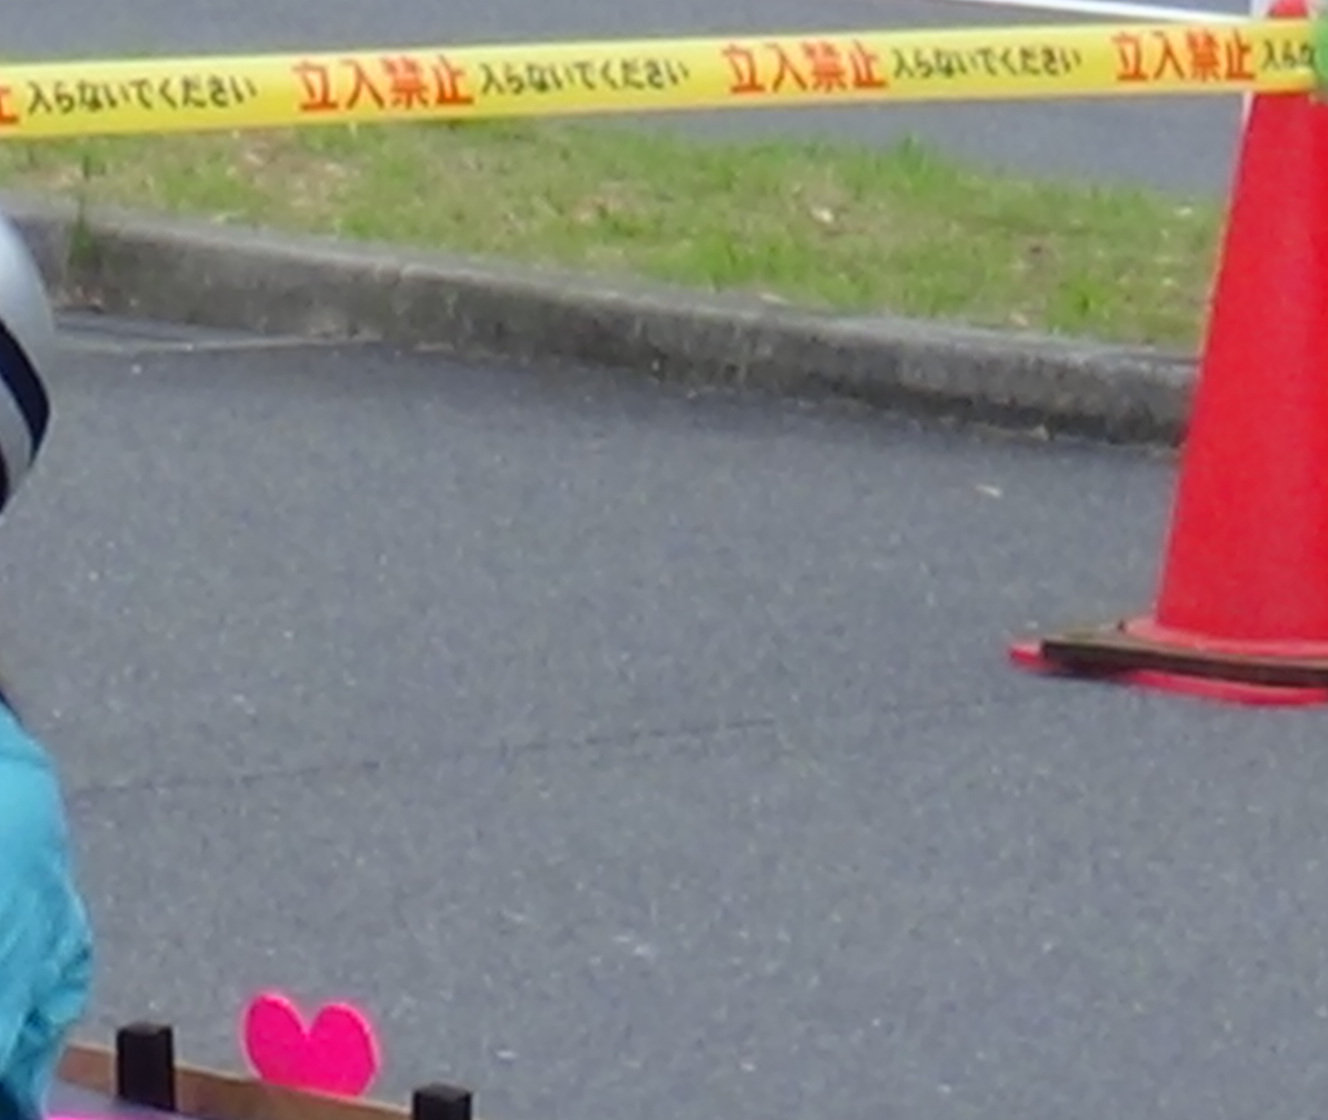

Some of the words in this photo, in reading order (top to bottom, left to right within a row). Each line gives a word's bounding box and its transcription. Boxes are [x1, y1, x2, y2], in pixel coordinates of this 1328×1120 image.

[721, 40, 888, 94] 立入禁止
[891, 46, 1082, 79] 入らないでください
[1112, 29, 1256, 82] 立入禁止
[26, 74, 257, 115] 入らないでください
[292, 54, 475, 113] 立入禁止
[478, 58, 689, 96] 入らないでください
